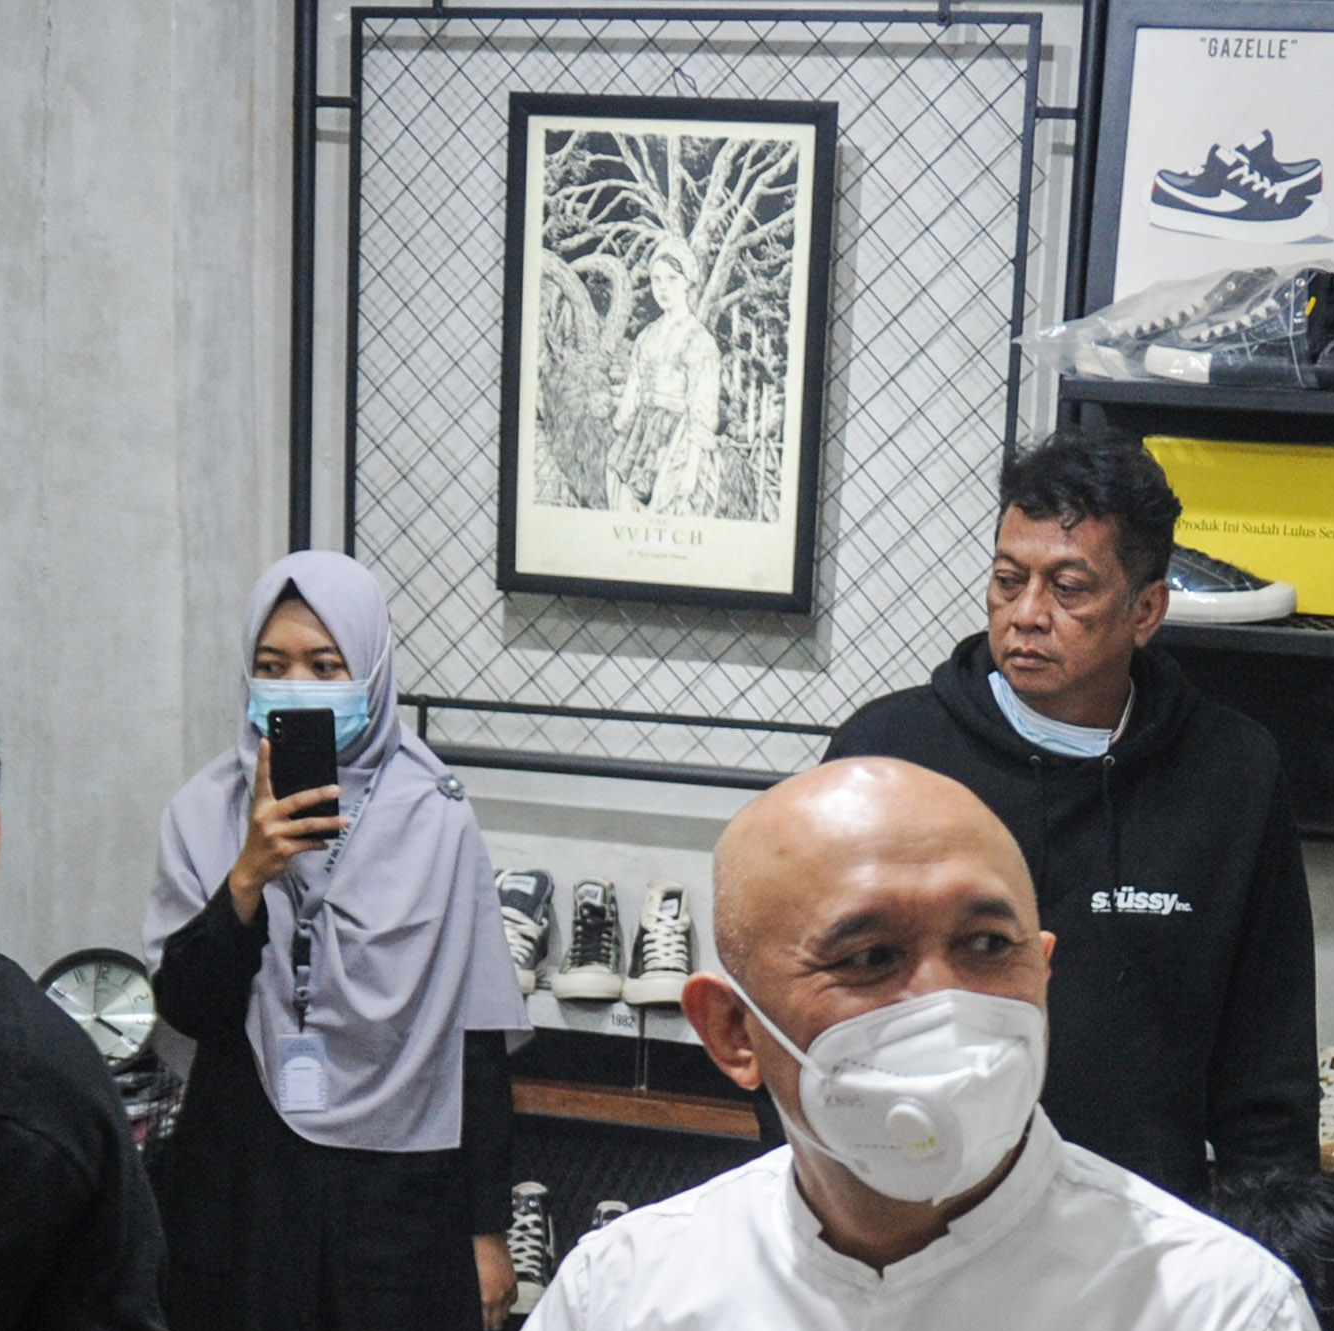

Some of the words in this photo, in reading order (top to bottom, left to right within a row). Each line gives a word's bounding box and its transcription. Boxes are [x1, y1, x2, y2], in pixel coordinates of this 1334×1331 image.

[1199, 37, 1298, 59] "GAZELLE"
[1176, 518, 1220, 532] Produk
[1223, 520, 1240, 533] Ini
[1242, 521, 1280, 536] Sudah
[1283, 523, 1316, 538] Lulus
[610, 1013, 635, 1028] 1982
